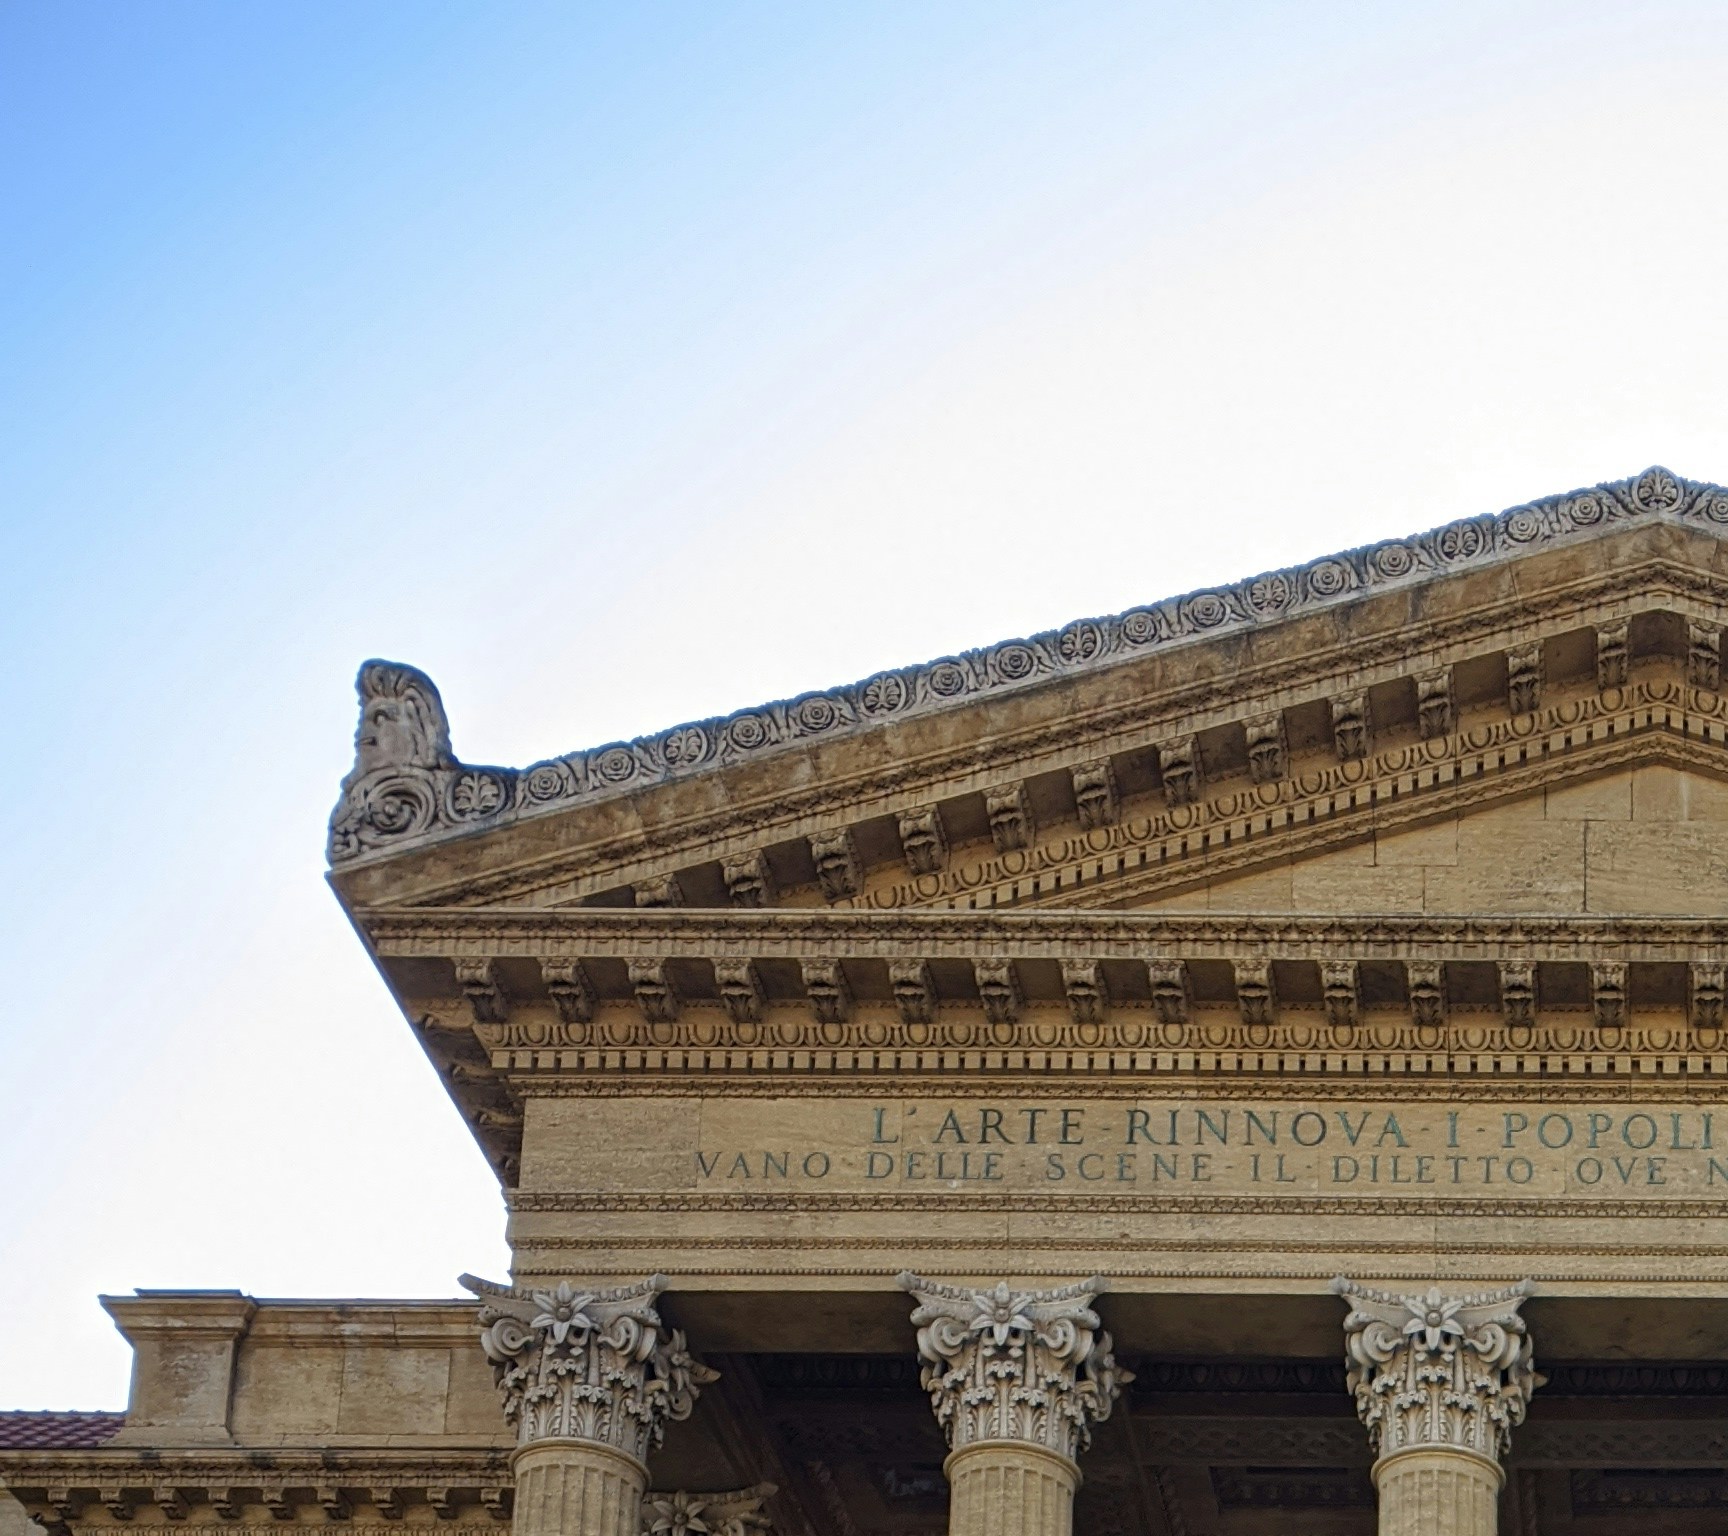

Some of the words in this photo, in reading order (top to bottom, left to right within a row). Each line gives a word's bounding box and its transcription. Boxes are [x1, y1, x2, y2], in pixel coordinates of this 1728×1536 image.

[871, 1106, 1085, 1145] L'ARTE
[1125, 1108, 1411, 1148] RINNOVA
[1446, 1111, 1460, 1148] I
[1501, 1112, 1714, 1150] POPOLI
[695, 1150, 831, 1179] VANO
[864, 1151, 1005, 1181] DELLE
[1045, 1152, 1213, 1183] SCENE
[1250, 1154, 1297, 1183] IL
[1332, 1154, 1534, 1185] DILETTO
[1575, 1156, 1668, 1185] OVE
